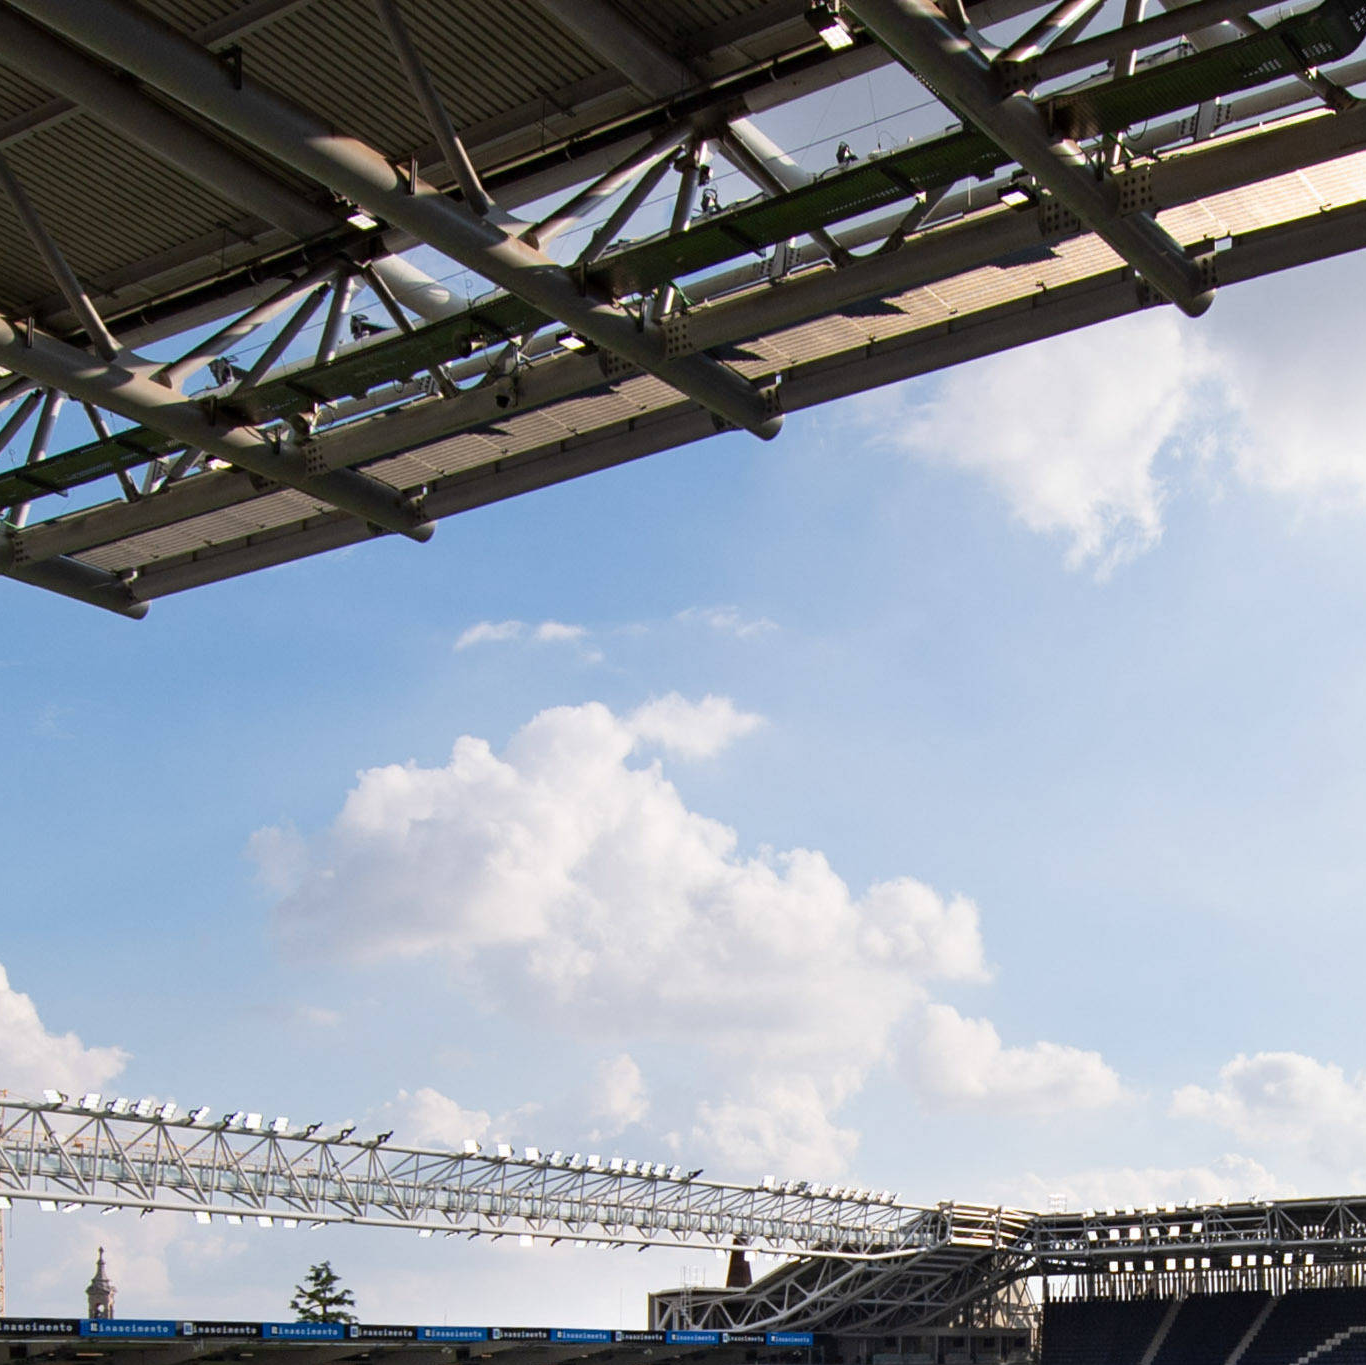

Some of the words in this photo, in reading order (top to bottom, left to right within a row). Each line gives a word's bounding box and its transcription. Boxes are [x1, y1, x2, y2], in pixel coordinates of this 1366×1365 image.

[91, 1323, 169, 1334] Rinascimento
[185, 1323, 257, 1336] Rinascimento
[271, 1325, 338, 1336] Rinascimento
[350, 1325, 413, 1338] Rinascimento
[425, 1328, 483, 1339] Rinascimento
[493, 1328, 548, 1340] Rinascimento
